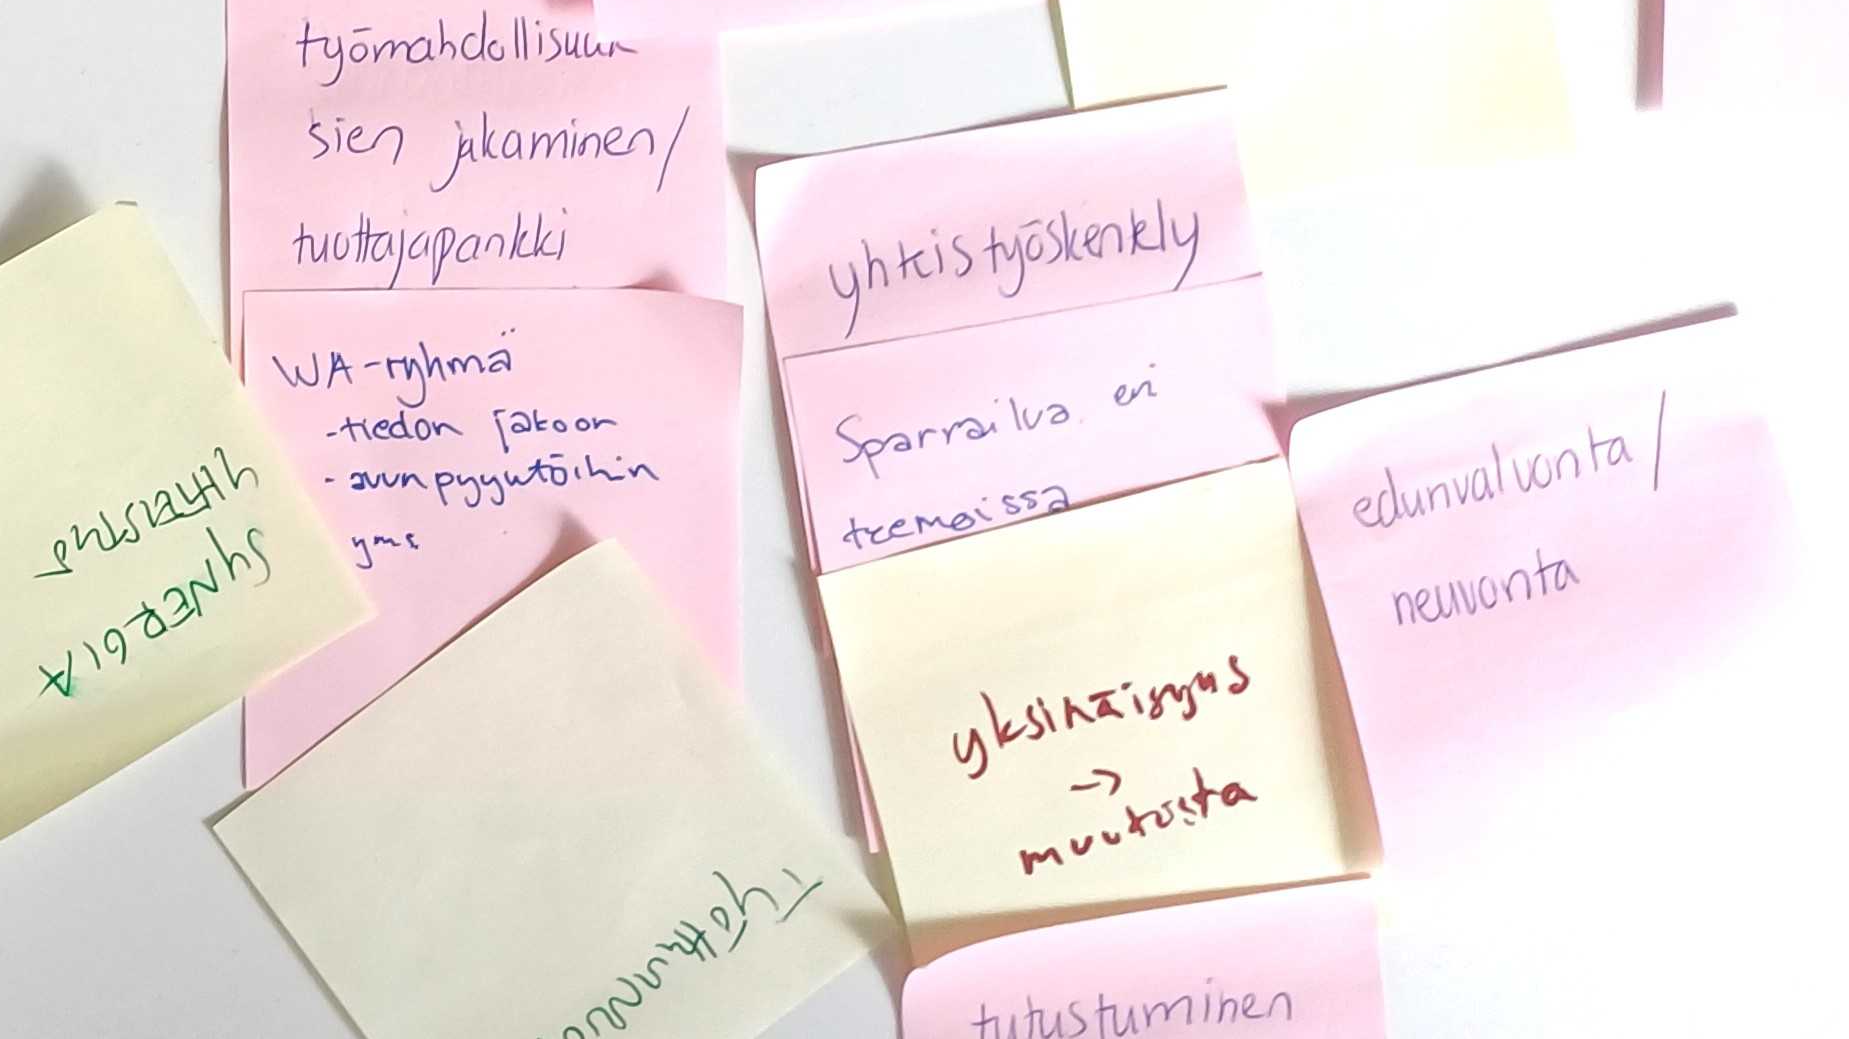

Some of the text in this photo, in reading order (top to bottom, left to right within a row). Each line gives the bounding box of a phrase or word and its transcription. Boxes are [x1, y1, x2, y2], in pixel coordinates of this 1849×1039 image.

[296, 9, 641, 87] työmahdollisuu
[292, 206, 571, 290] tuottajapankki
[38, 527, 271, 698] SYNERGIA
[1391, 548, 1581, 627] neuvonta
